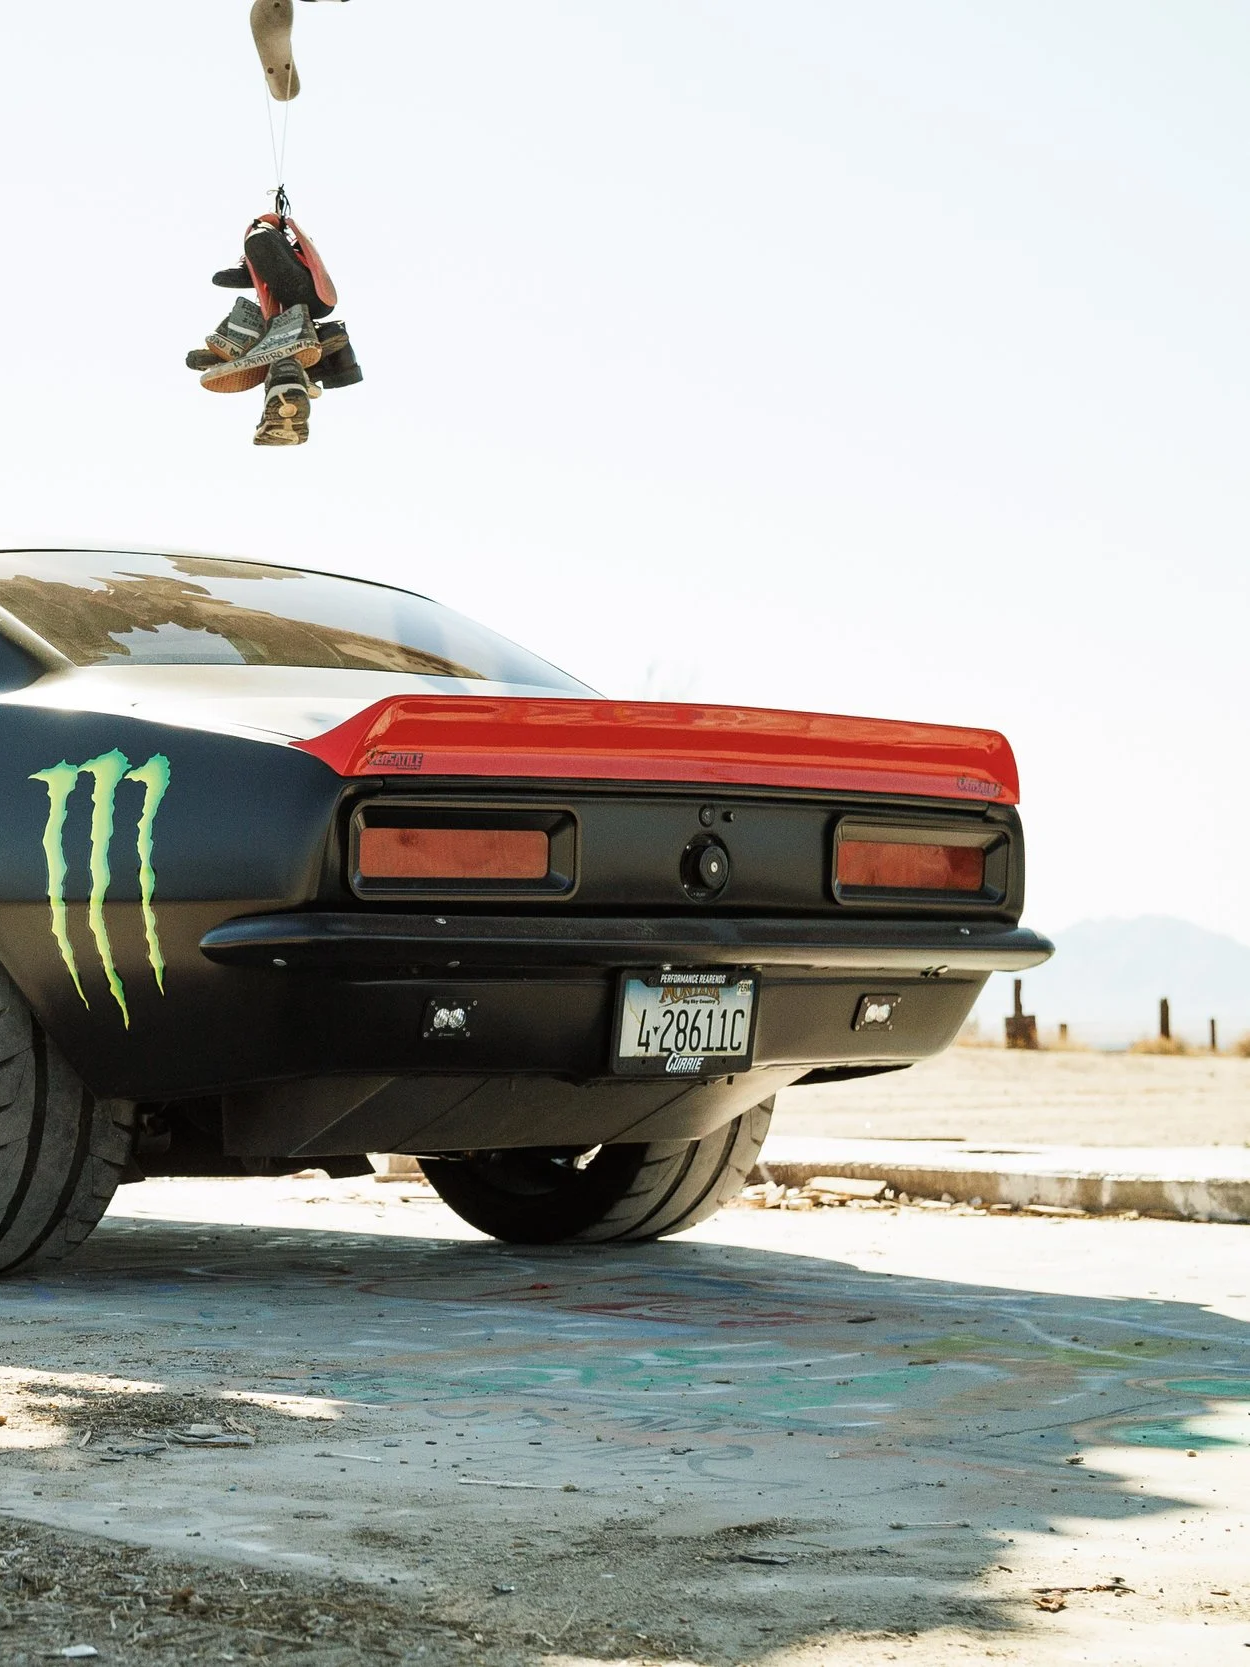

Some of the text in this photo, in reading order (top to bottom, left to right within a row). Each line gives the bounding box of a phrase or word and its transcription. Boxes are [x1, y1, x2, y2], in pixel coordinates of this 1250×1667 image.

[660, 973, 727, 984] PERFORMANCE REARENDS
[637, 1009, 745, 1053] 4 28611C
[665, 1052, 705, 1072] CURRIE
